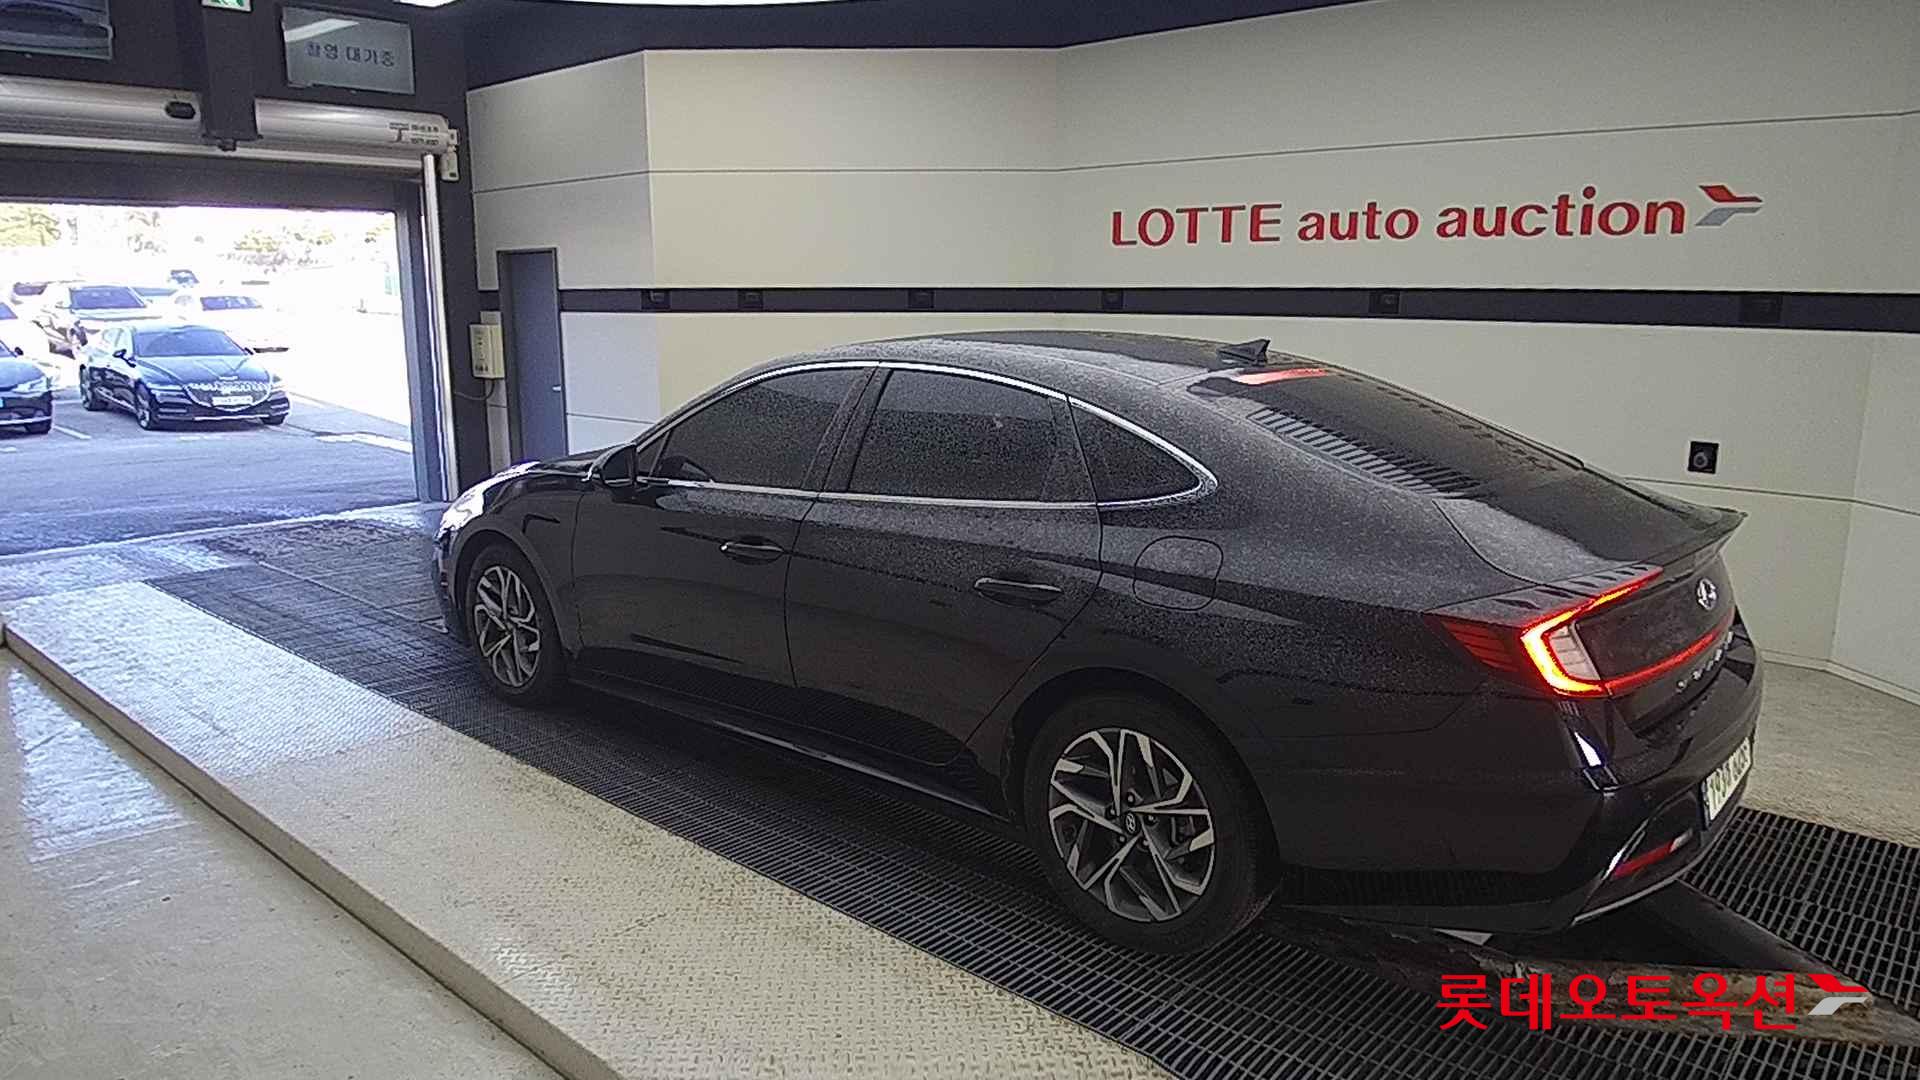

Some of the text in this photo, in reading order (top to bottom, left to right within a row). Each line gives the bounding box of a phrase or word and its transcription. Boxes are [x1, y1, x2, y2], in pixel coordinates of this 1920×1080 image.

[346, 46, 395, 67] 대기중
[1112, 186, 1686, 246] LOTTE auto auction
